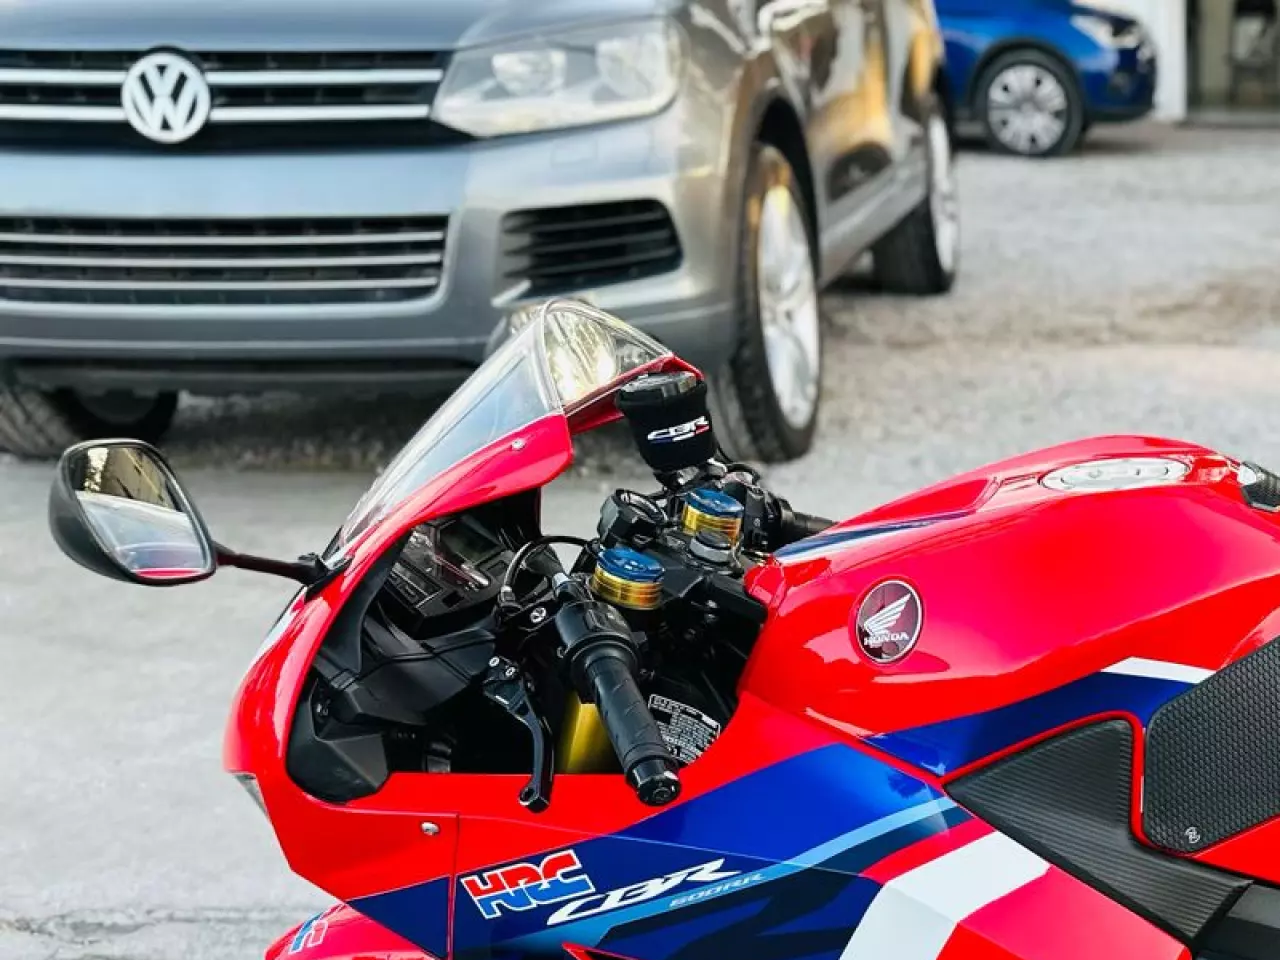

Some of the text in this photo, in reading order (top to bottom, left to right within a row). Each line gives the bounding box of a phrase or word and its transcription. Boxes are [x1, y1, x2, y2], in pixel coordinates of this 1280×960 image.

[648, 415, 709, 441] CBR
[863, 632, 909, 647] HONDA
[547, 858, 743, 925] CBR
[669, 872, 766, 908] 600RR
